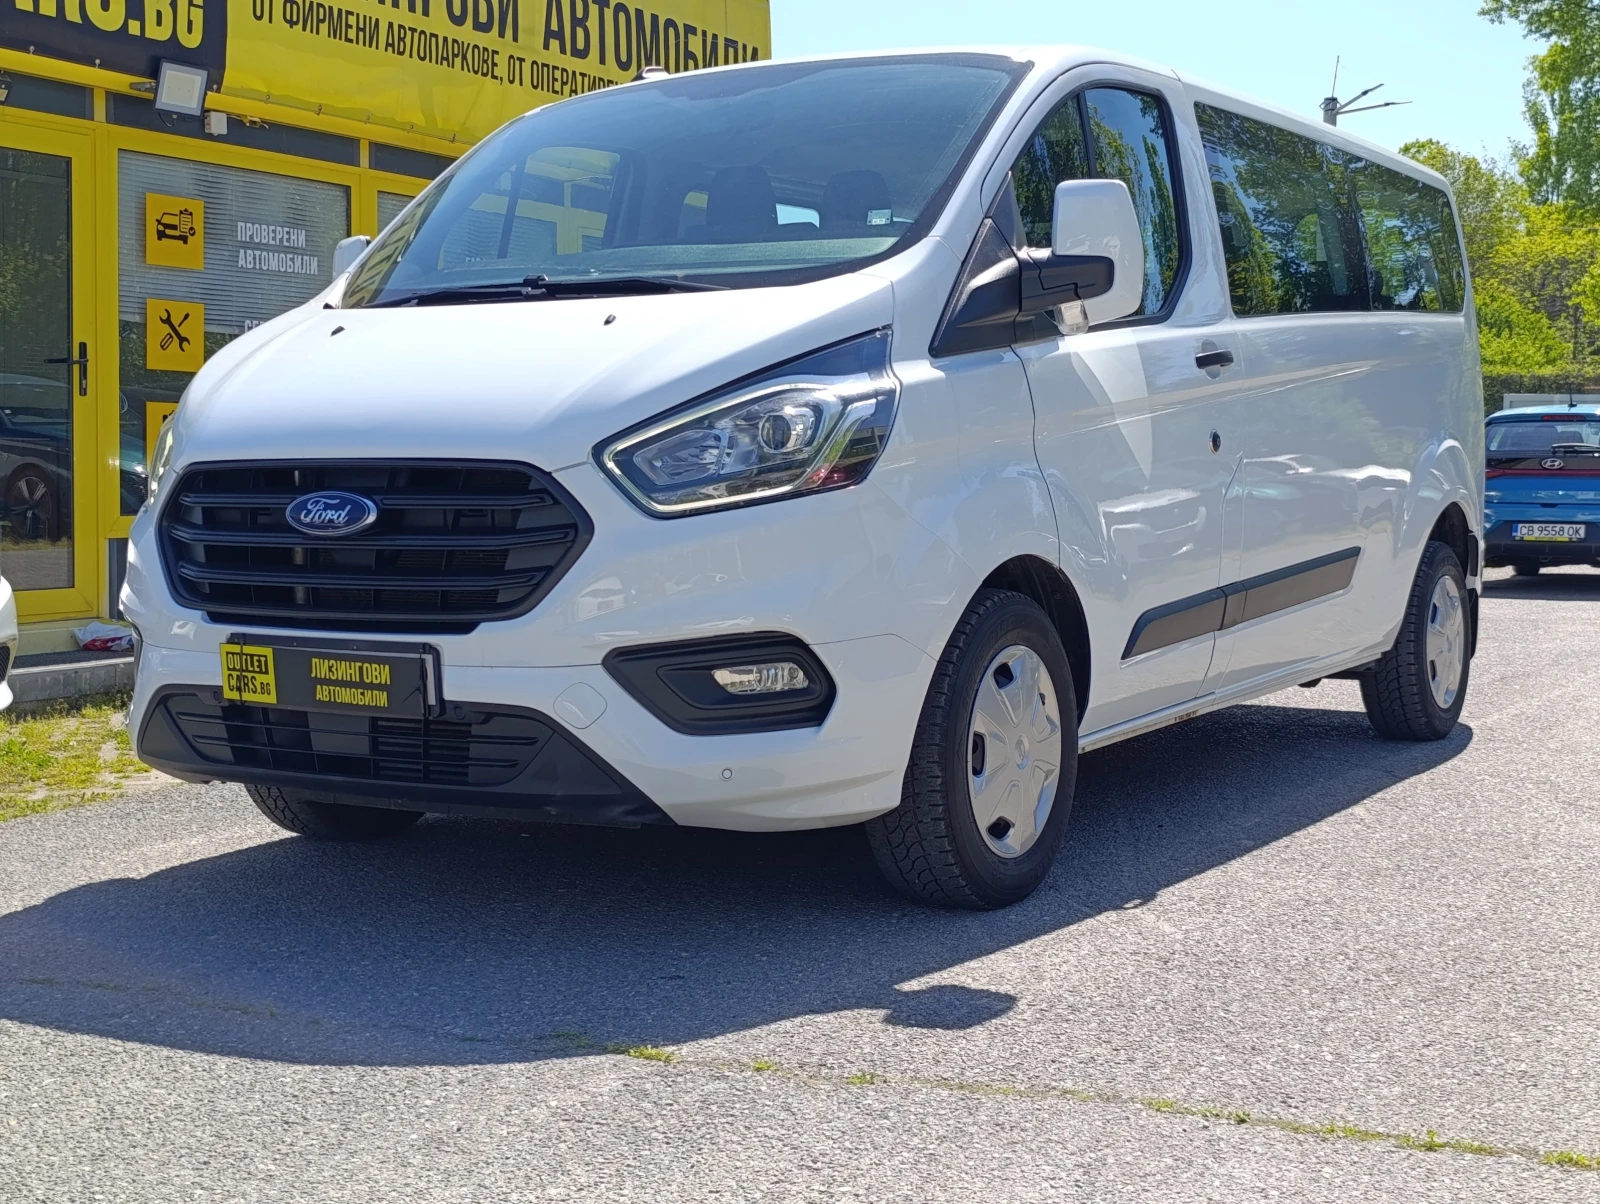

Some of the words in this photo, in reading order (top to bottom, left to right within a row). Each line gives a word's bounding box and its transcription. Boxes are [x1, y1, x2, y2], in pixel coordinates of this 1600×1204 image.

[282, 0, 380, 51] ФИРМЕНИ
[384, 21, 503, 86] АВТОПАРКОВЕ,
[507, 54, 526, 87] ОТ
[237, 222, 306, 248] ПРОВЕРЕНИ
[238, 249, 318, 275] АВТОМОБИЛИ
[301, 498, 351, 524] Ford
[1537, 526, 1564, 537] 9558
[227, 653, 266, 672] OUTLET
[311, 657, 391, 685] ЛИЗИНГОВИ
[227, 673, 271, 696] CARS.BG
[316, 684, 388, 708] АВТОМОБИЛИ
